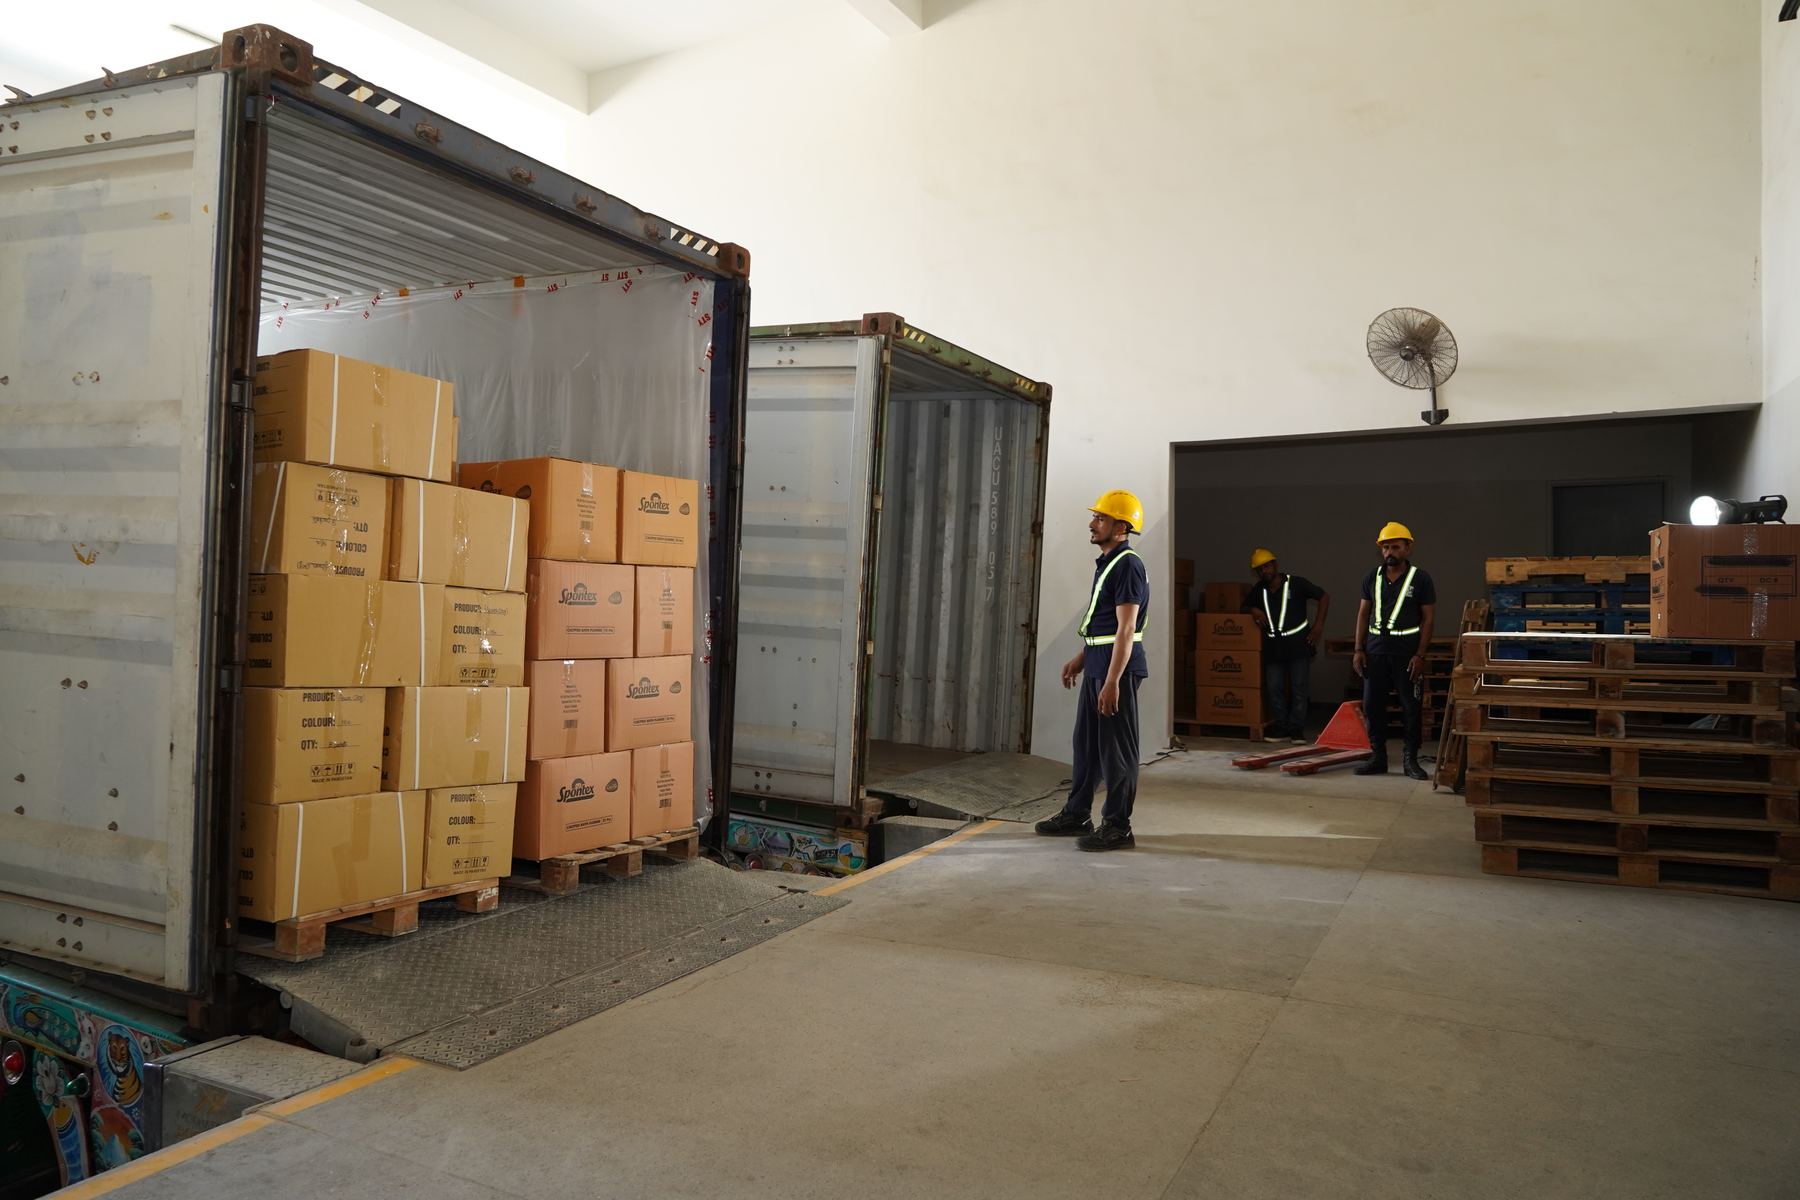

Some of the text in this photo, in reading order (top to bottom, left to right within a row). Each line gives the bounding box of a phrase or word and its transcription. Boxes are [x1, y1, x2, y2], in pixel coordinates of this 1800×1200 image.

[617, 271, 629, 280] STY
[683, 271, 695, 284] STY
[546, 283, 559, 293] STY
[622, 280, 632, 293] STY
[690, 290, 699, 306] STY
[276, 316, 284, 329] STY
[697, 313, 711, 327] STY
[991, 426, 1003, 486] UACU
[638, 496, 670, 512] Spontex
[353, 522, 368, 533] QTY:
[558, 588, 598, 605] Spontex
[453, 625, 482, 635] COLOUR:
[452, 644, 467, 654] QTY:
[625, 683, 660, 699] Spontex
[303, 692, 335, 702] PRODUCT:
[302, 718, 336, 728] COLOUR:
[301, 740, 318, 750] QTY:
[450, 793, 477, 803] PRODUCT:
[557, 785, 594, 802] Spontex
[448, 816, 476, 825] COLOUR:
[446, 836, 461, 845] QTY:
